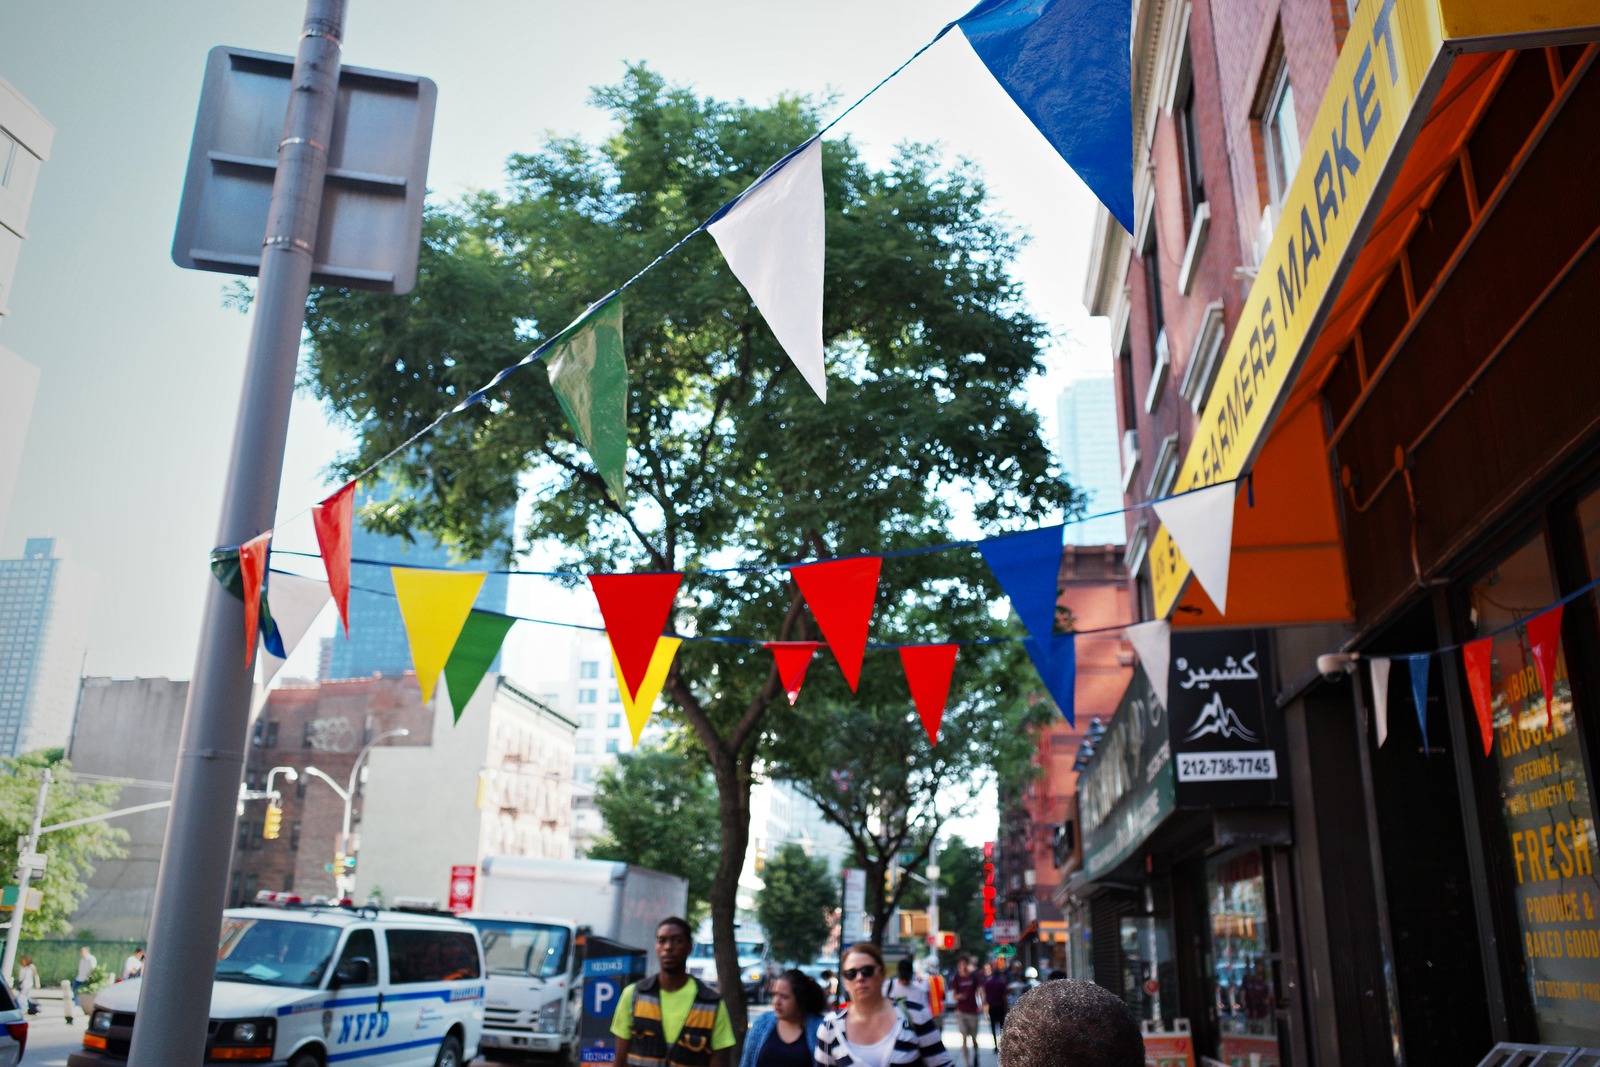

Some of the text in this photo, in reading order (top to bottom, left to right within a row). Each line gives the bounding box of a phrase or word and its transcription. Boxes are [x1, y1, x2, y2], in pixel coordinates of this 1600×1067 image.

[1202, 0, 1398, 488] FARMERS MARKET
[1183, 757, 1271, 776] 212-736-7745
[1514, 752, 1561, 785] OFFERING A
[1529, 783, 1563, 811] VARIETY
[1564, 780, 1576, 801] OF
[1512, 817, 1593, 884] FRESH
[1526, 891, 1595, 924] PRODUCE &
[1525, 931, 1563, 958] BAKED
[594, 982, 615, 1013] P
[337, 1011, 390, 1044] NYPD
